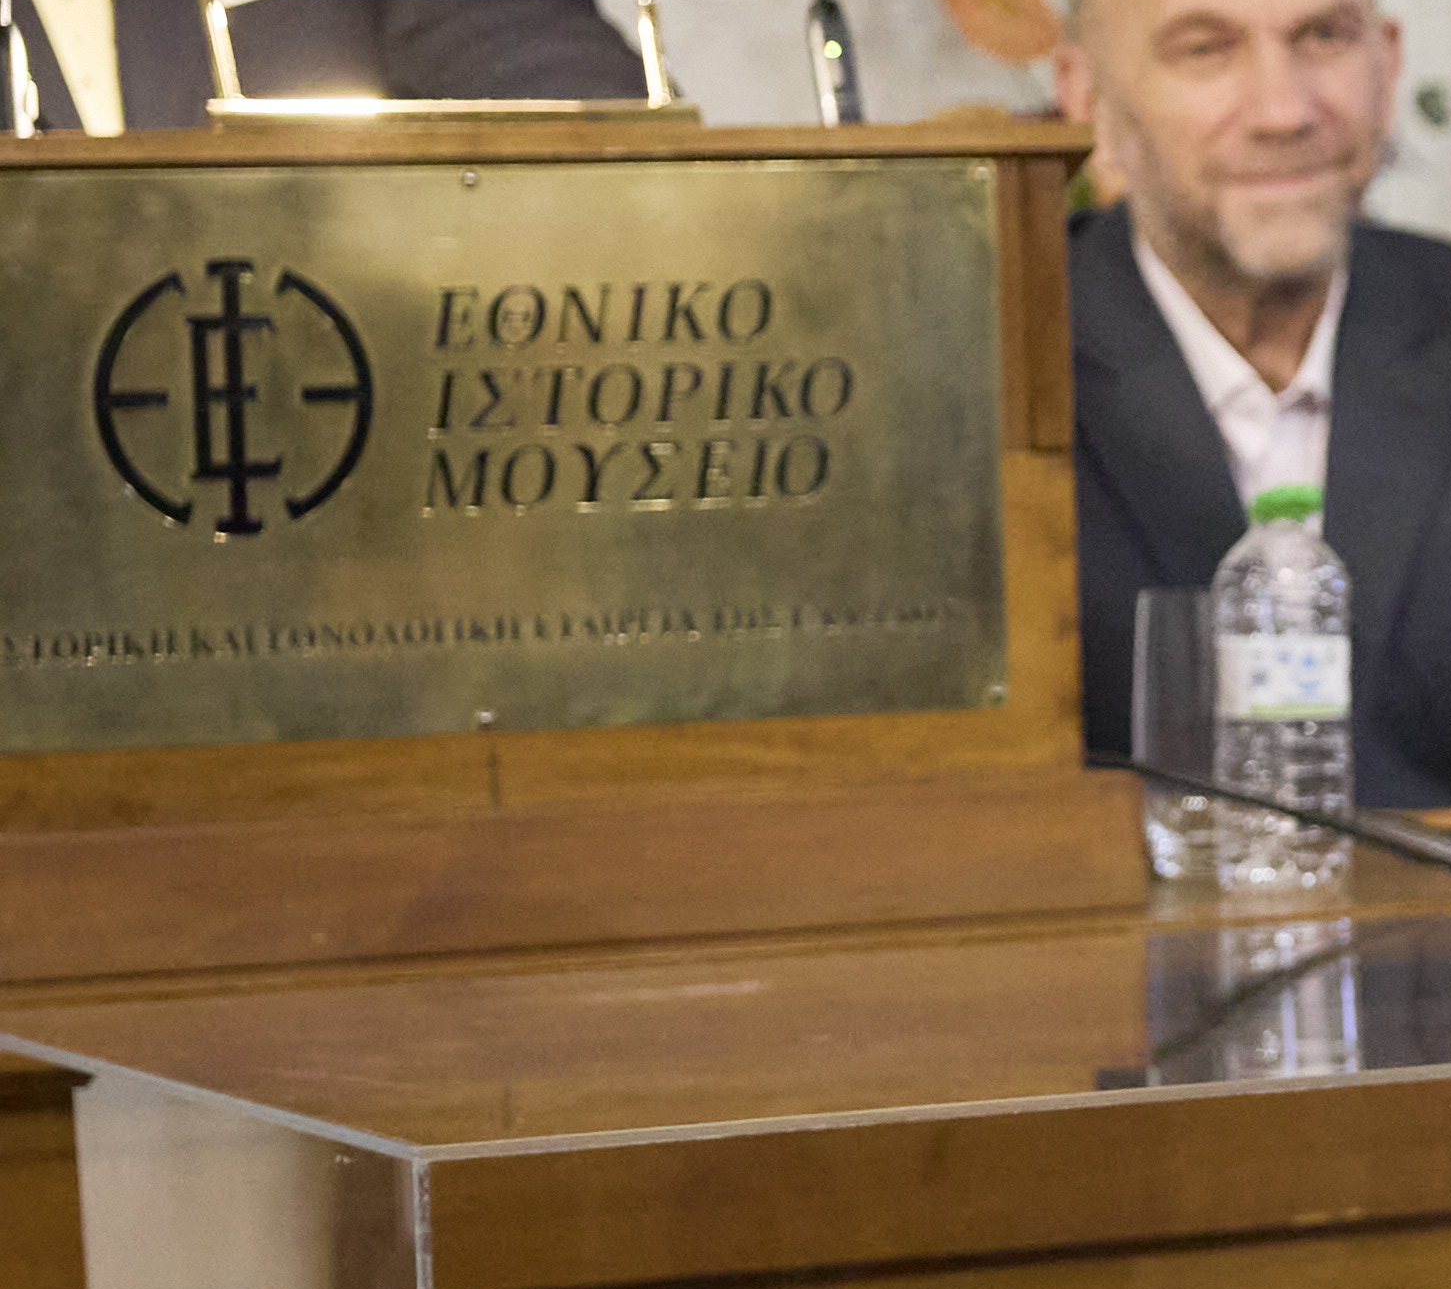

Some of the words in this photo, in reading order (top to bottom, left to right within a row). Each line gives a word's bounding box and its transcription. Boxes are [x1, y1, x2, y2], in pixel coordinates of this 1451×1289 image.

[433, 278, 774, 351] ΕΘΝΙΚΟ
[431, 355, 855, 432] ΙΣΤΟΡΙΚΟ
[421, 435, 832, 511] ΜΟΥΣΕΙΟ
